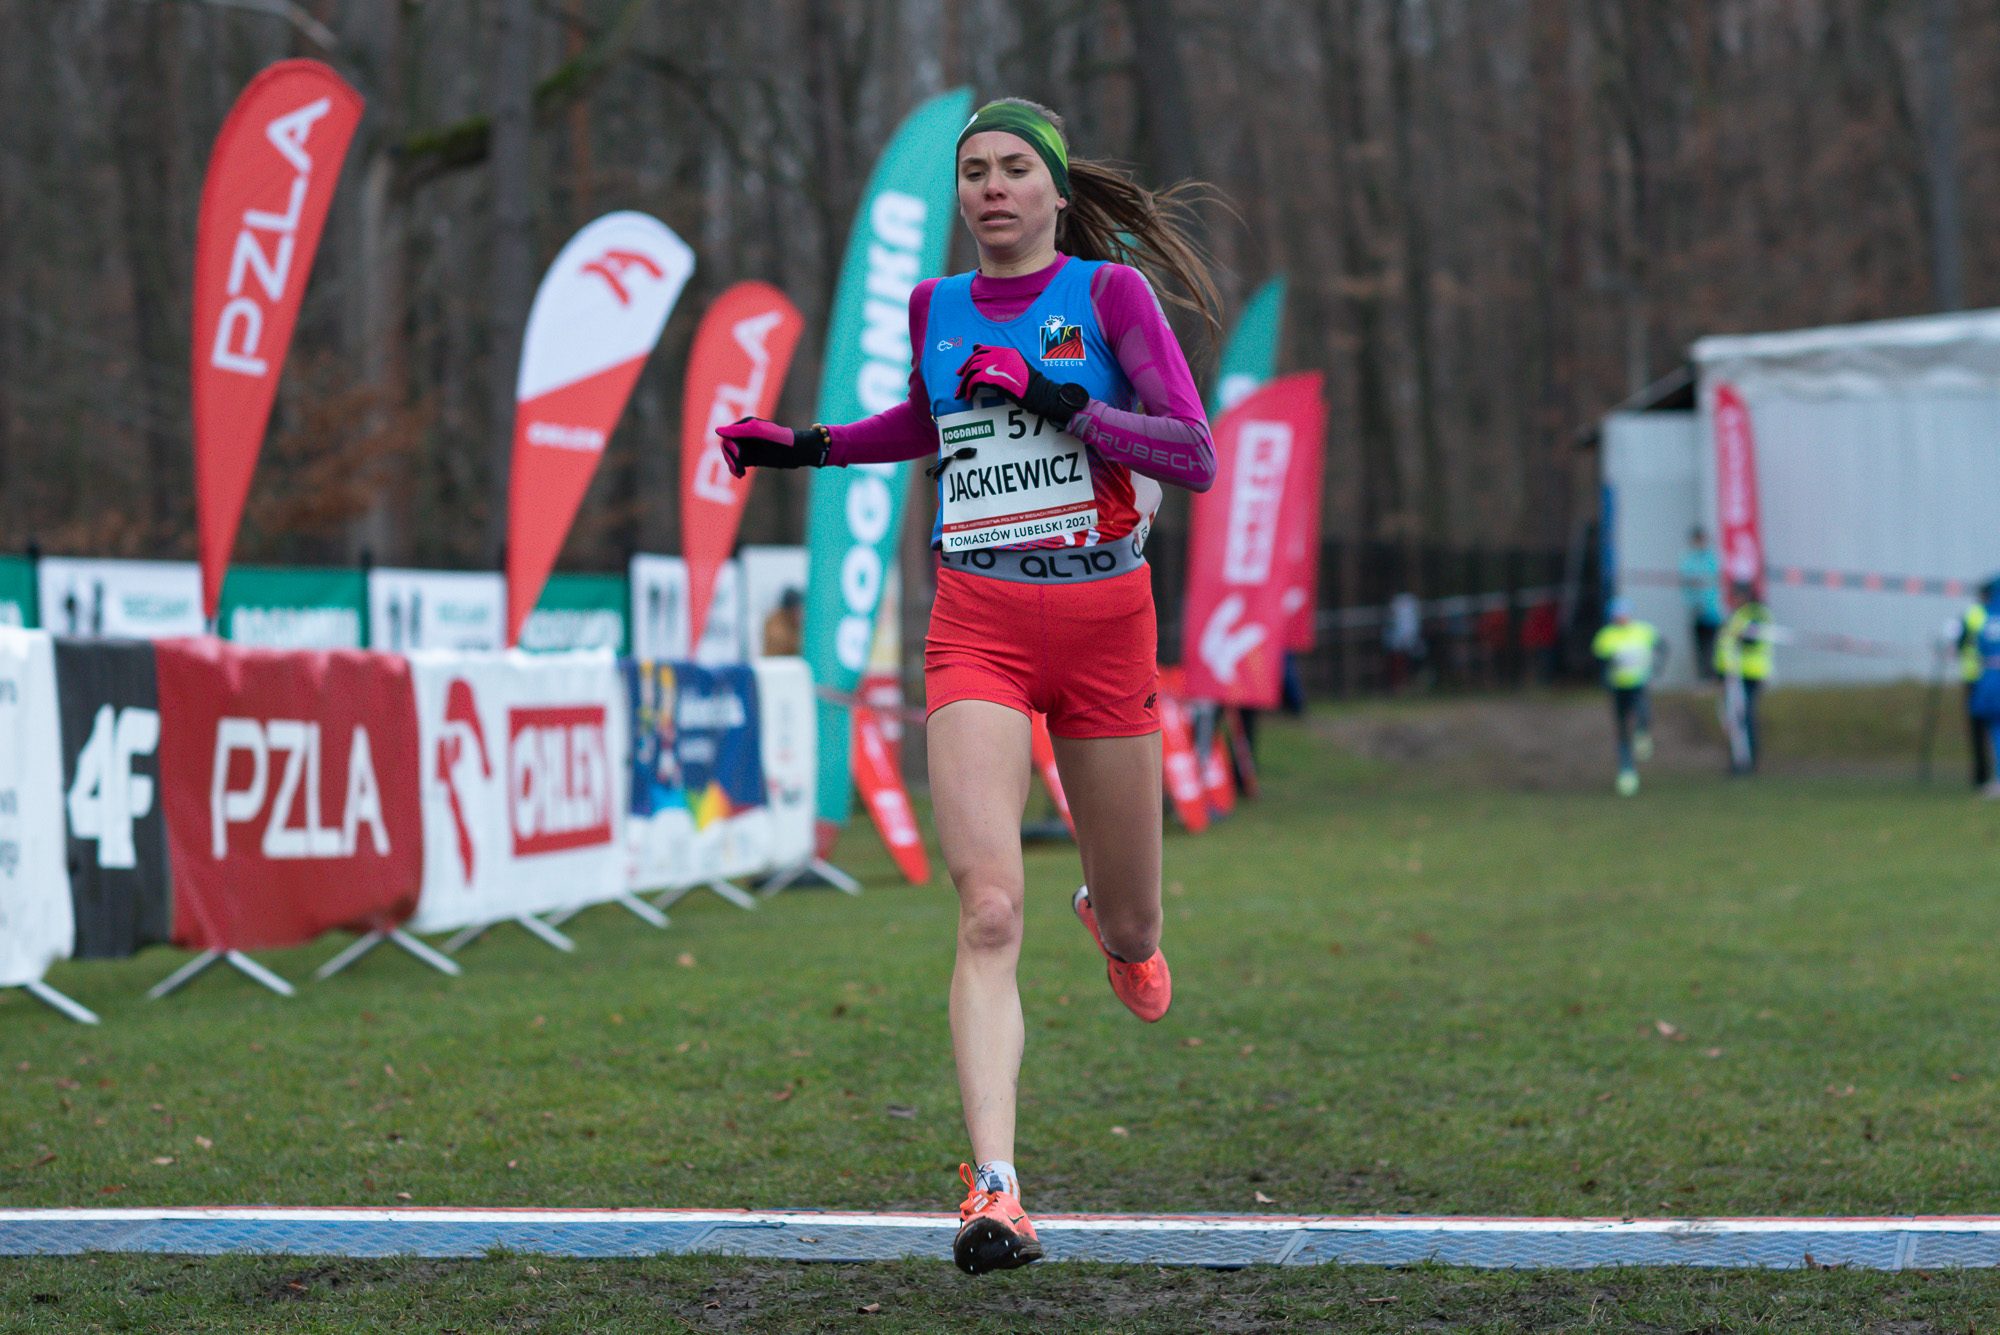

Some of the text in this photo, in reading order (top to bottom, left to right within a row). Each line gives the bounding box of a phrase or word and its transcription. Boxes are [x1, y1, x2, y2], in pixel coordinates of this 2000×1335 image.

[211, 97, 332, 377] PZLA
[944, 424, 992, 441] BOGDANKA
[949, 451, 1083, 503] JACKIEWICZ
[949, 515, 1091, 547] TOMASZÓW LUBELSKI 2021
[1143, 692, 1157, 709] 4F
[69, 704, 161, 868] 4F
[211, 718, 391, 861] PZLA
